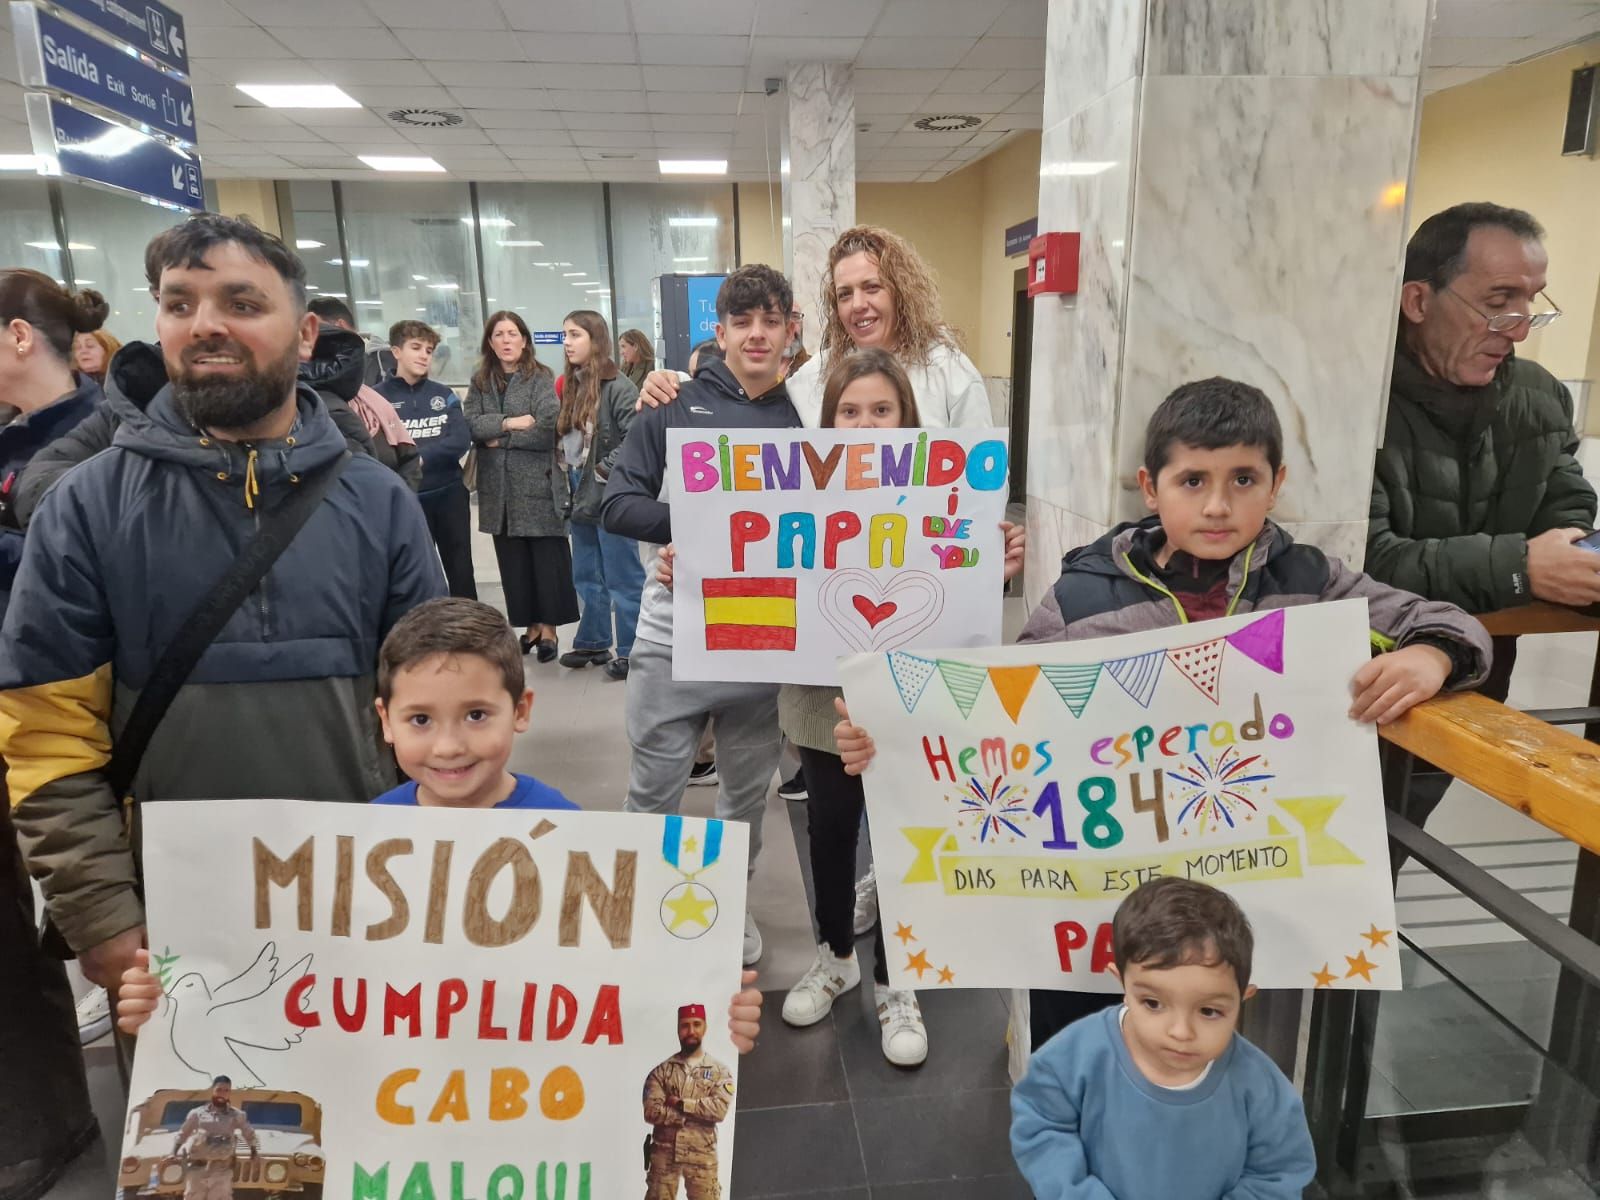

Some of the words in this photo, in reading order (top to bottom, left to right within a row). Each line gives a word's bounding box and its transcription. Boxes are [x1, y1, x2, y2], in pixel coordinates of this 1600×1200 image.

[44, 35, 99, 84] Salida
[106, 74, 125, 96] Exit
[131, 86, 156, 109] Sortie
[729, 495, 908, 572] PAPÁ
[922, 516, 973, 539] LOVE
[931, 544, 979, 570] YOU
[922, 735, 1053, 782] Hemos
[1090, 692, 1295, 769] esperado
[1032, 768, 1169, 850] 184
[252, 818, 638, 948] MISIÓN
[954, 867, 996, 891] DIAS
[1020, 867, 1078, 892] PARA
[1102, 864, 1162, 892] ESTE
[1185, 846, 1288, 881] MOMENTO
[284, 973, 623, 1046] CUMPLIDA
[375, 1065, 586, 1126] CABO
[351, 1161, 592, 1200] MALQUI
